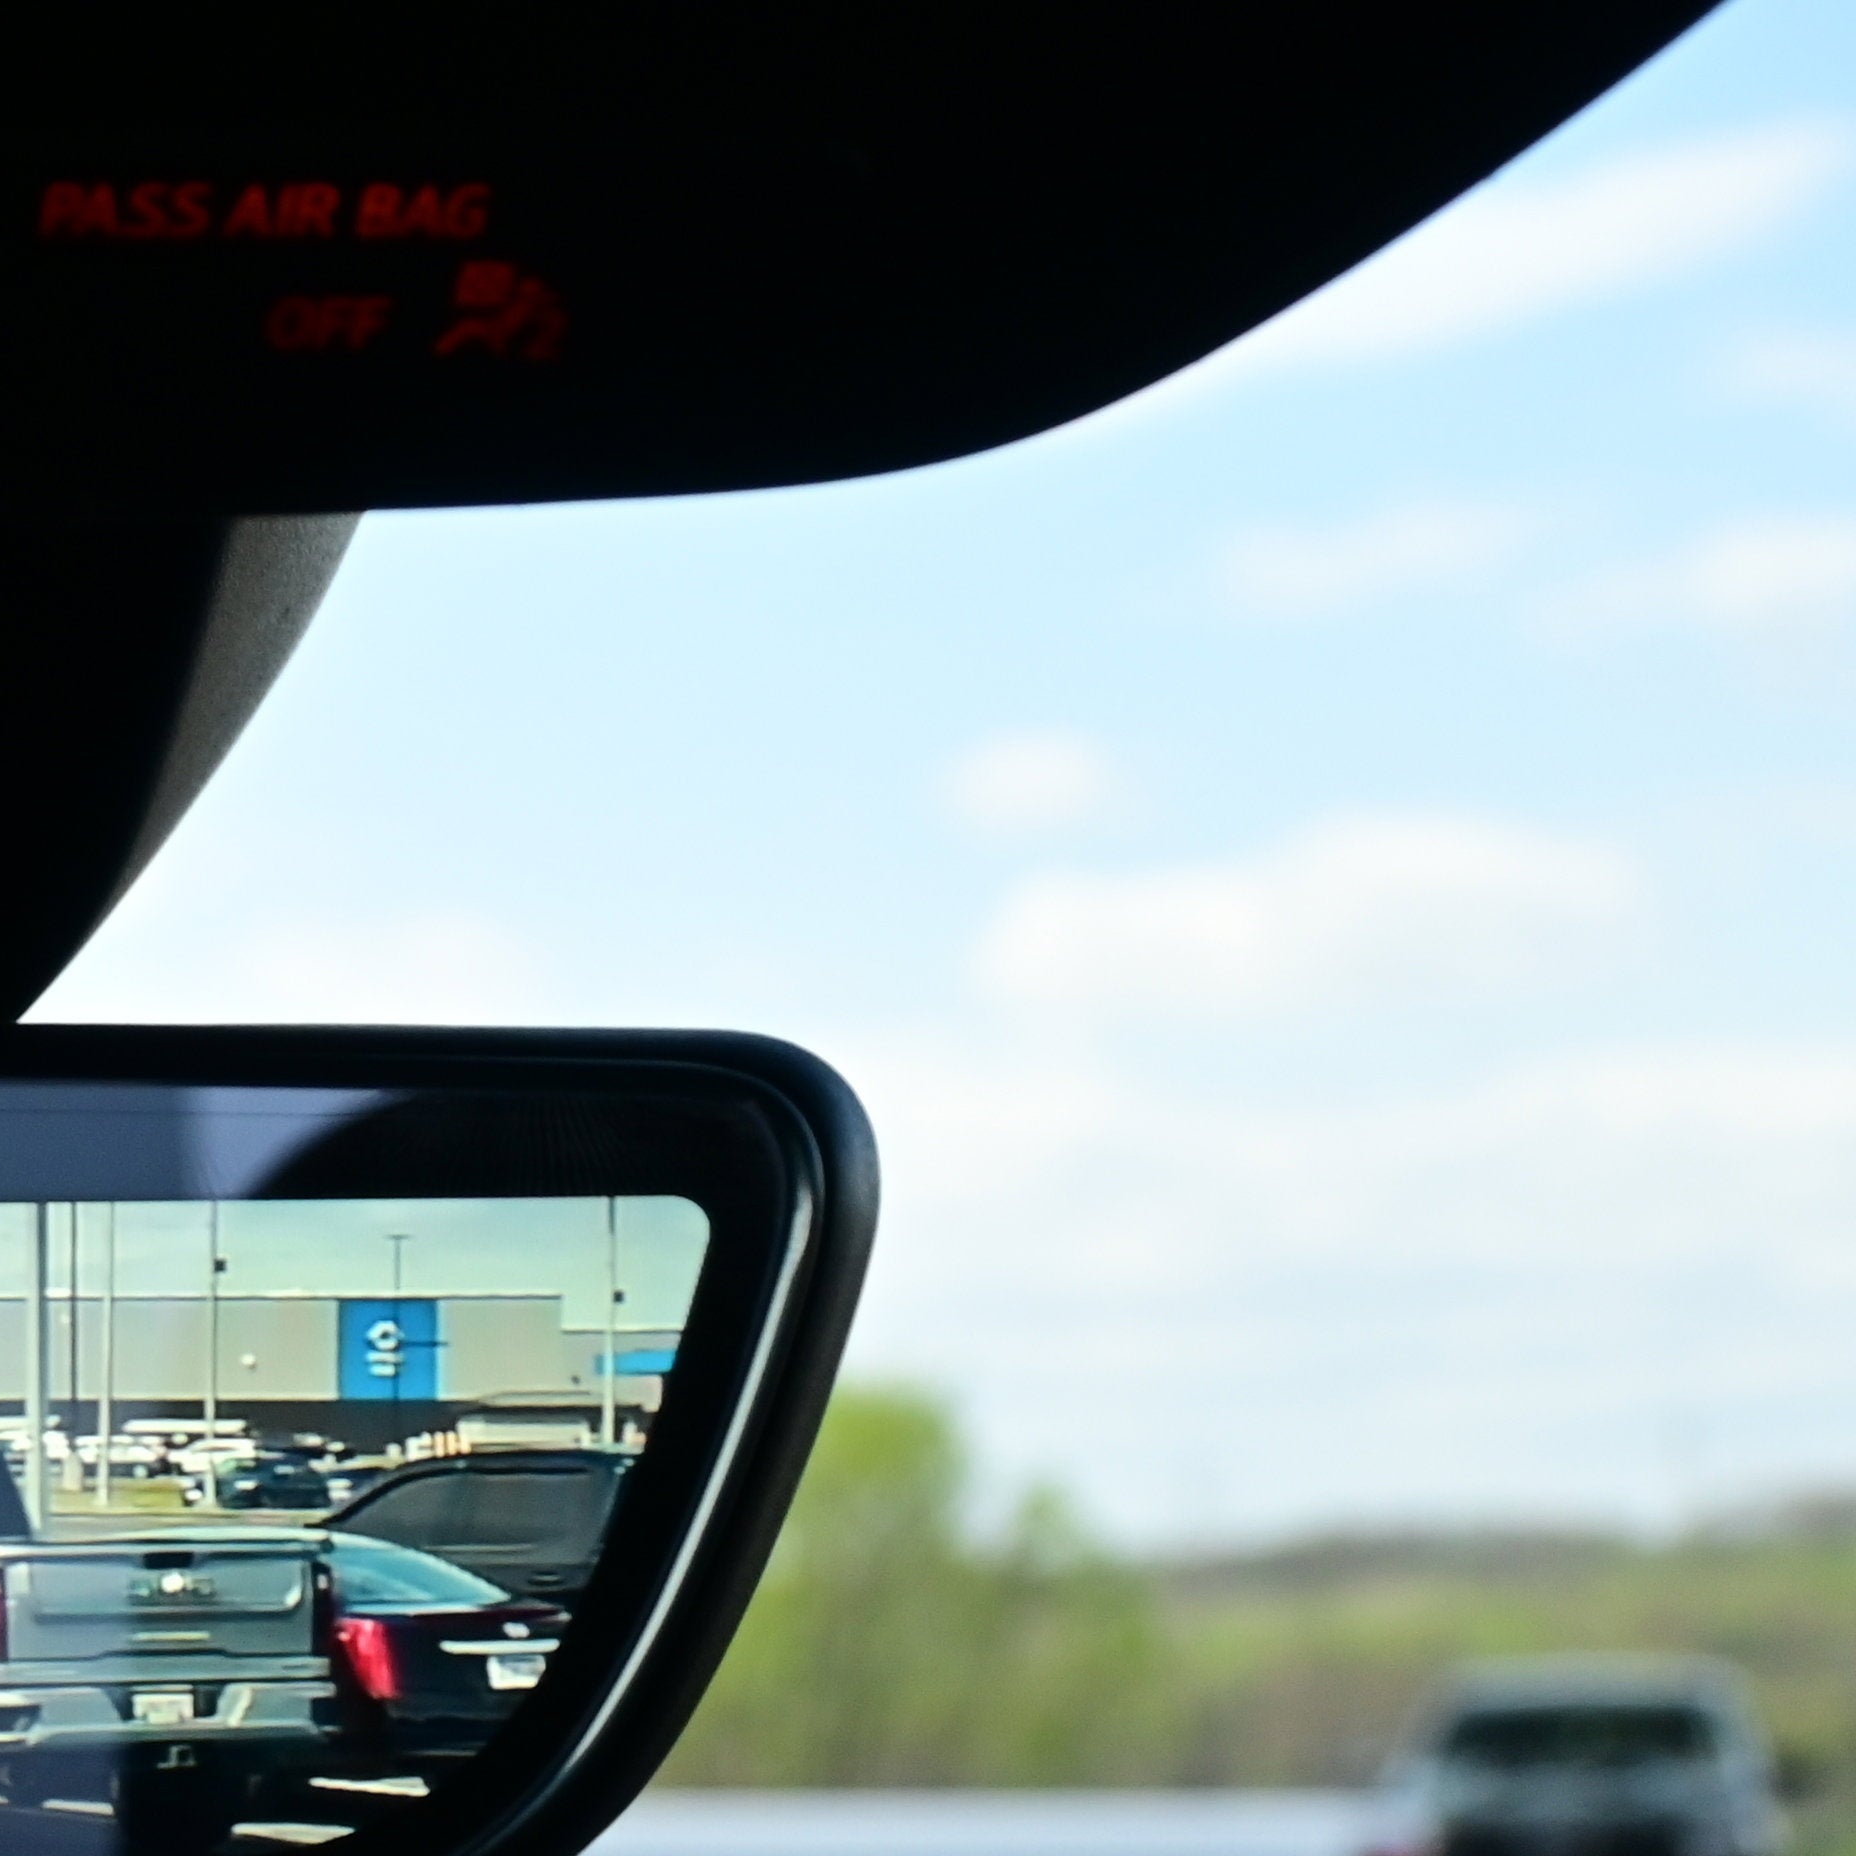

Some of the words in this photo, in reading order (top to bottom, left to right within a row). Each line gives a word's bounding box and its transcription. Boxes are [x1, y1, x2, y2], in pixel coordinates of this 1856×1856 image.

[40, 180, 212, 240] PASS
[224, 180, 340, 240] AIR
[354, 180, 493, 240] BAG
[264, 291, 398, 352] OFF
